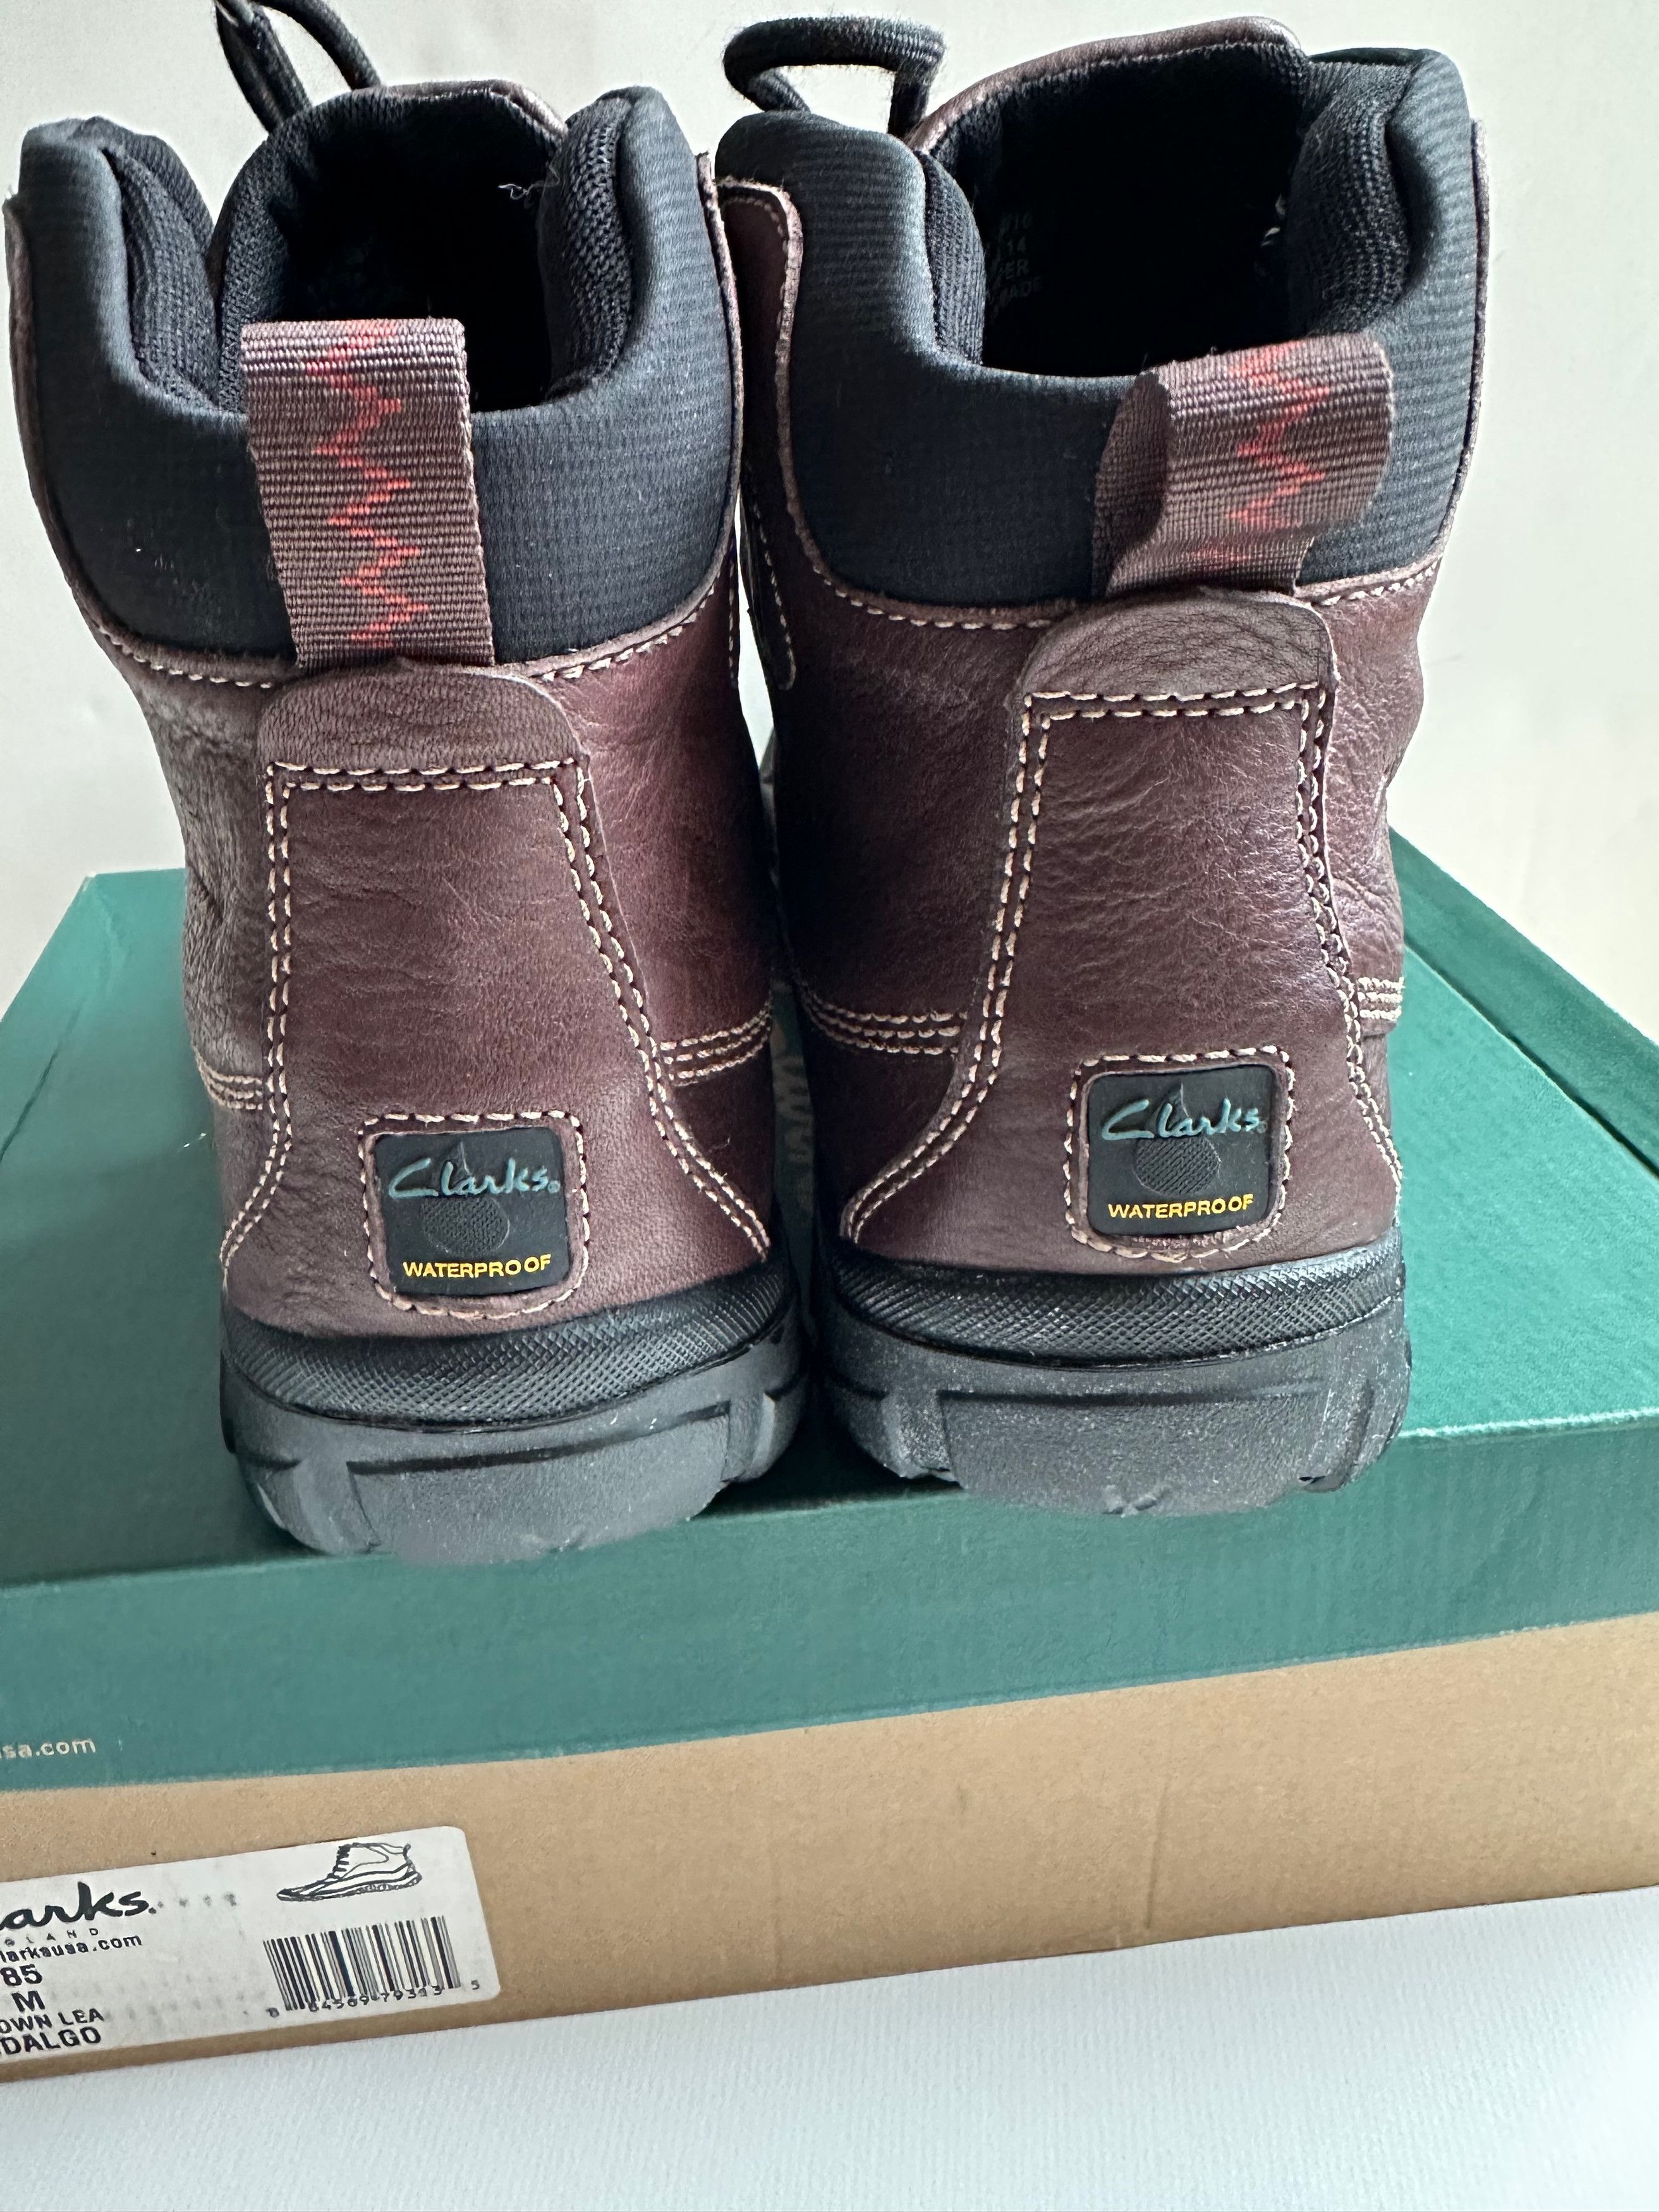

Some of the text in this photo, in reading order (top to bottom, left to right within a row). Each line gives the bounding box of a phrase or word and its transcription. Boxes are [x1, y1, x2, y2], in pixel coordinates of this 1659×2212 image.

[1107, 1193, 1254, 1219] WATERPROOF
[402, 1253, 552, 1279] WATERPROOF
[0, 1738, 96, 1759] sa.com
[1, 1964, 43, 1986] 85
[11, 1990, 46, 2013] M
[0, 2007, 104, 2034] OWN LEA
[0, 2026, 102, 2055] DALGO
